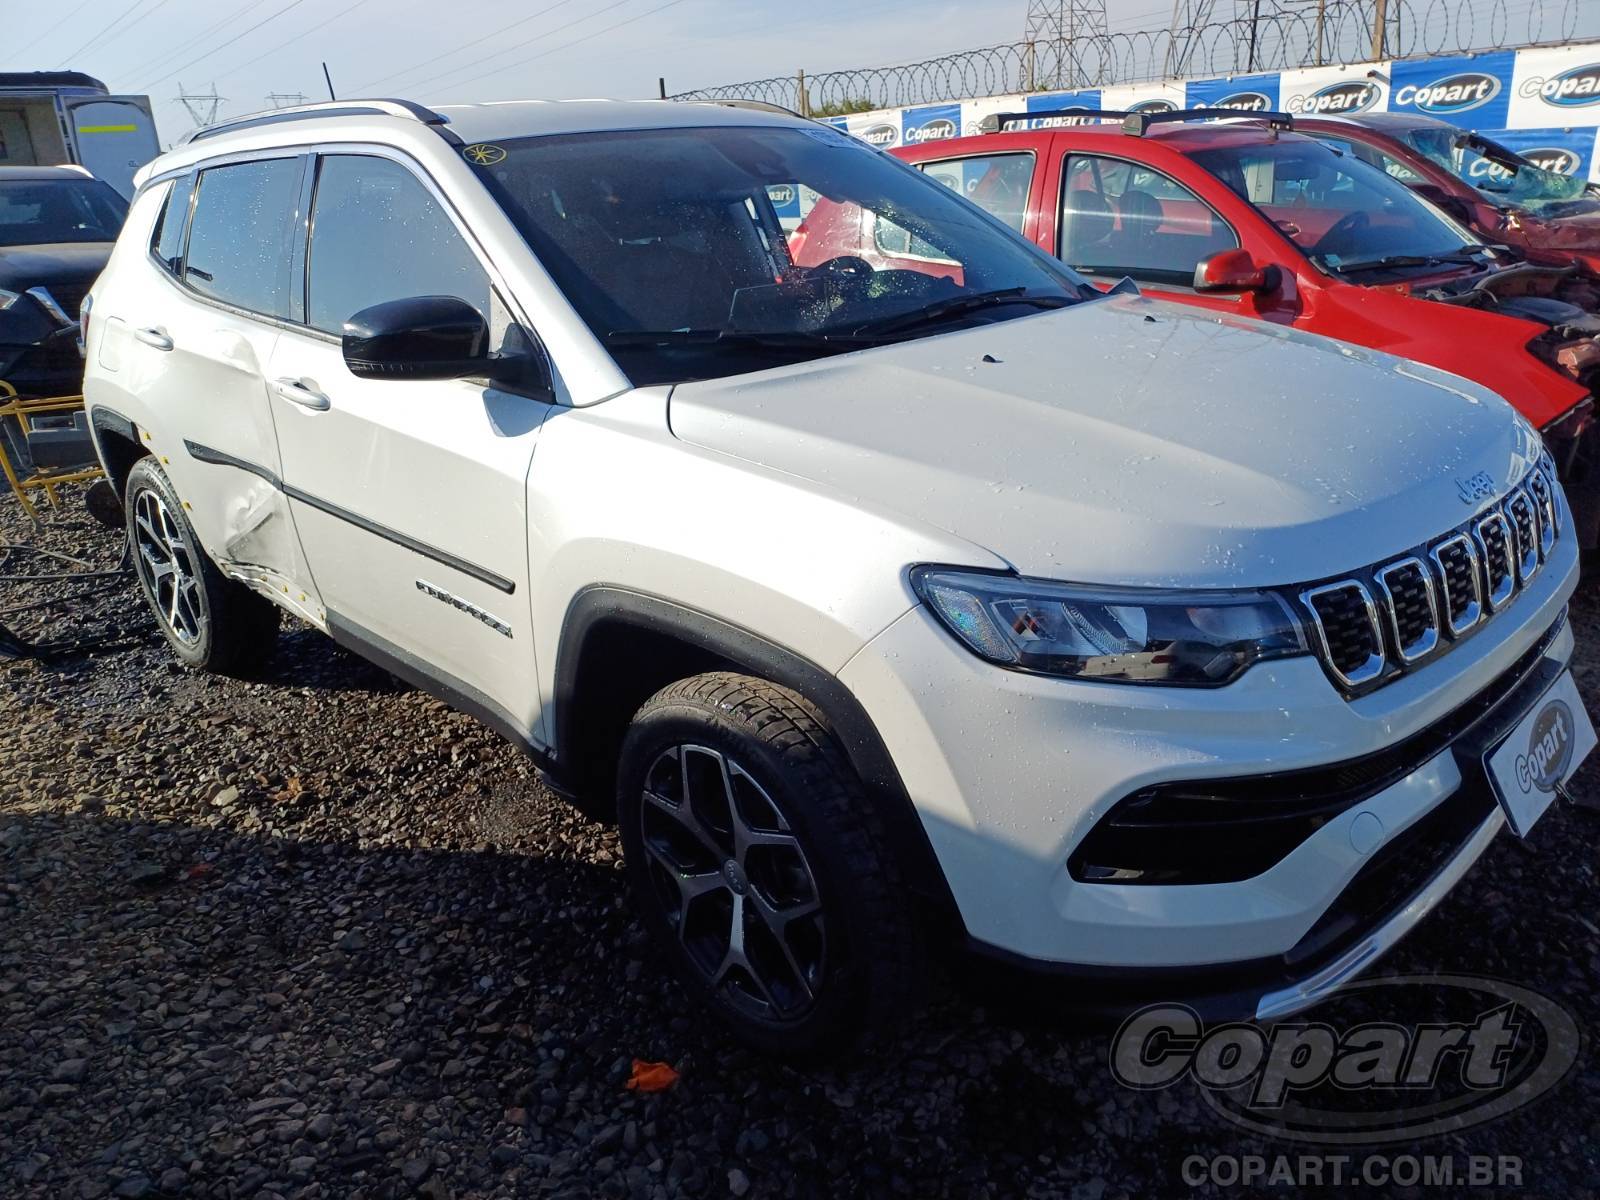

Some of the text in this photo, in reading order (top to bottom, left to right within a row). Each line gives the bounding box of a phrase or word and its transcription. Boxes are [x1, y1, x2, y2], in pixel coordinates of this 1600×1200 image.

[1395, 79, 1490, 106] Copart
[1519, 75, 1600, 100] Copa
[1285, 88, 1369, 113] Copart
[905, 123, 955, 142] Copart
[1515, 711, 1568, 794] Copart
